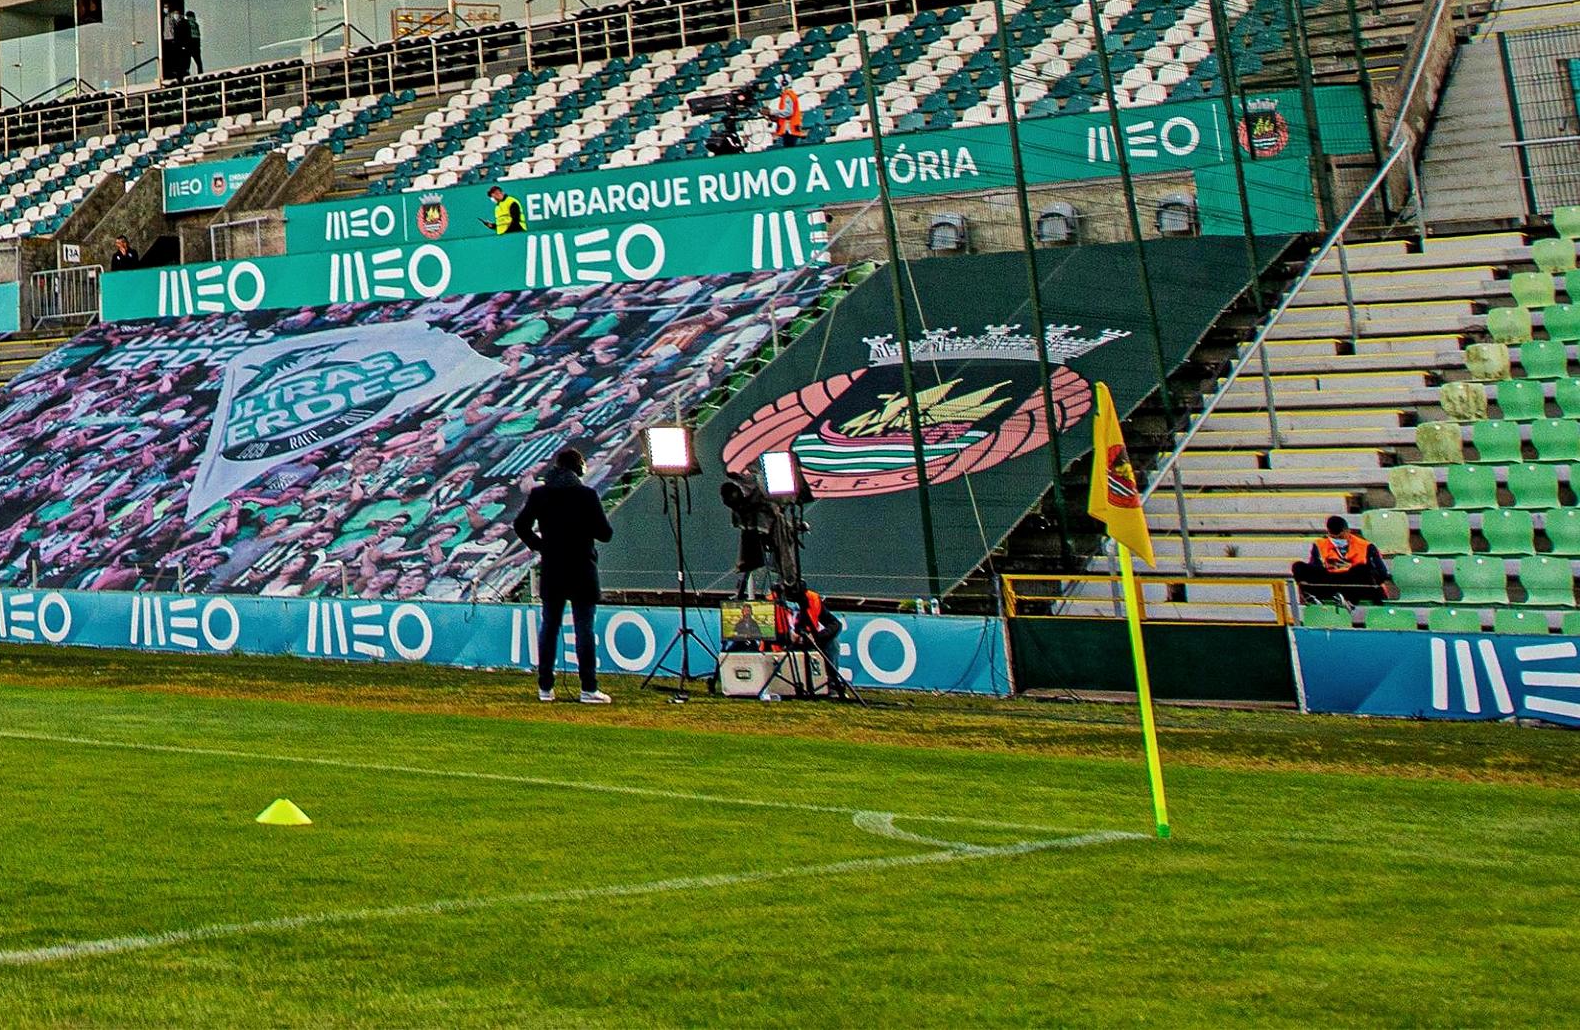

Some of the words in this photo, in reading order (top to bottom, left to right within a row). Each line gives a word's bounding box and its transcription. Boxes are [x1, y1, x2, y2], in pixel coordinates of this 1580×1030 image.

[1087, 116, 1200, 163] MEO
[169, 178, 202, 198] MEO
[526, 176, 691, 221] EMBARQUE
[699, 166, 796, 203] RUMO
[806, 153, 830, 193] À
[835, 142, 979, 190] VITÓRIA
[325, 205, 395, 241] MEO
[329, 244, 451, 303] MEO
[525, 223, 666, 288] MEO
[158, 261, 266, 316] MEO
[91, 345, 248, 371] VERDE
[226, 363, 428, 445] ERDES
[130, 595, 240, 651] MEO
[307, 601, 433, 661] MEO
